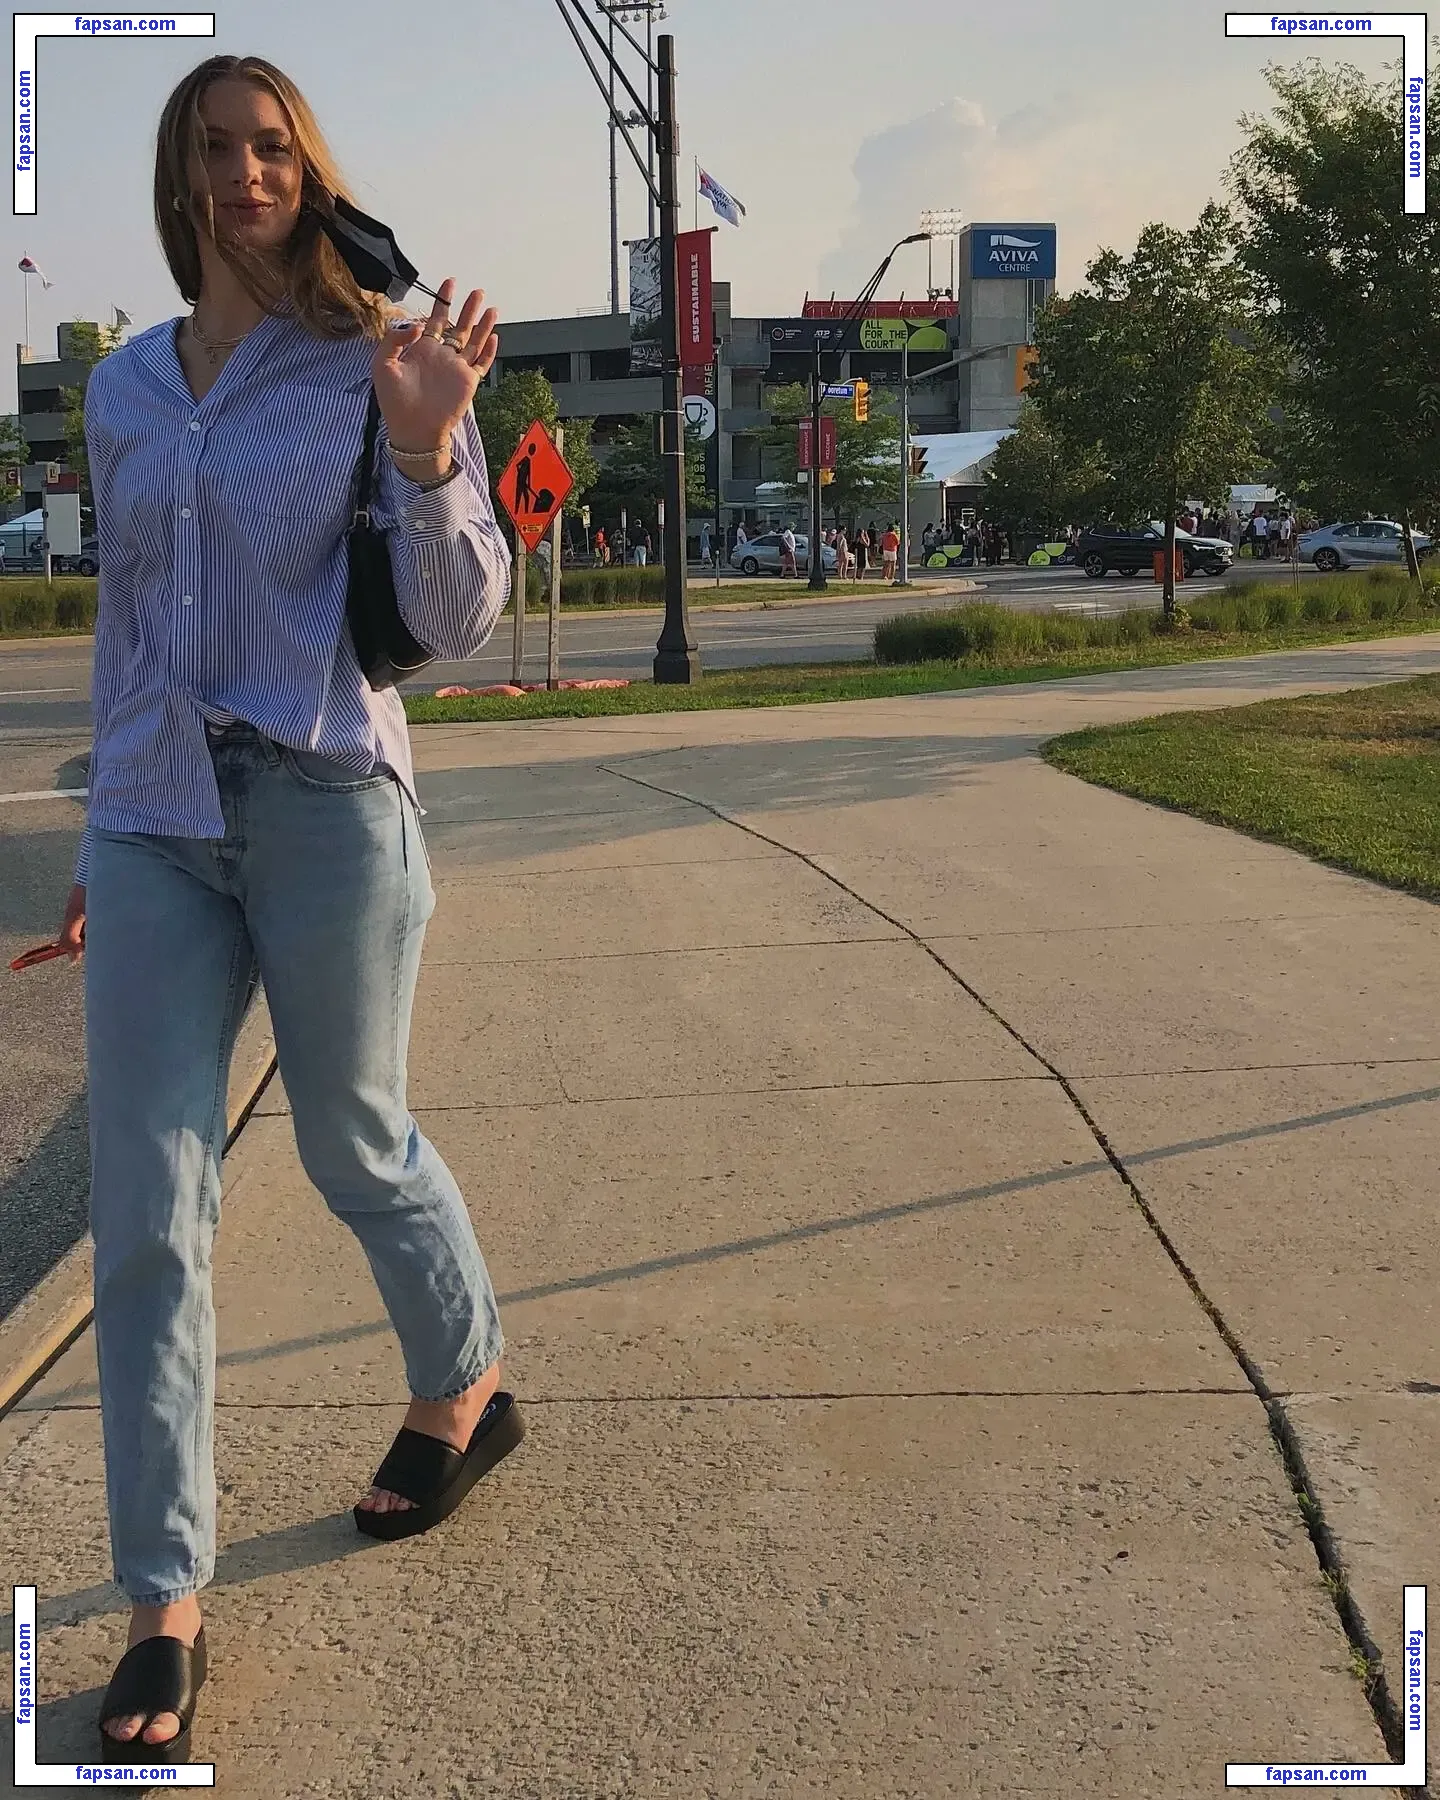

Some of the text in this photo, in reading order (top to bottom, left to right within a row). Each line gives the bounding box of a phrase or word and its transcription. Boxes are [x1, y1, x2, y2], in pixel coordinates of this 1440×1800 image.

[989, 250, 1039, 262] AVIVA
[998, 263, 1031, 272] CENTRE
[690, 252, 701, 344] SUSTAINABLE
[865, 319, 883, 330] ALL
[864, 329, 907, 340] FOR THE
[864, 339, 895, 349] COURT
